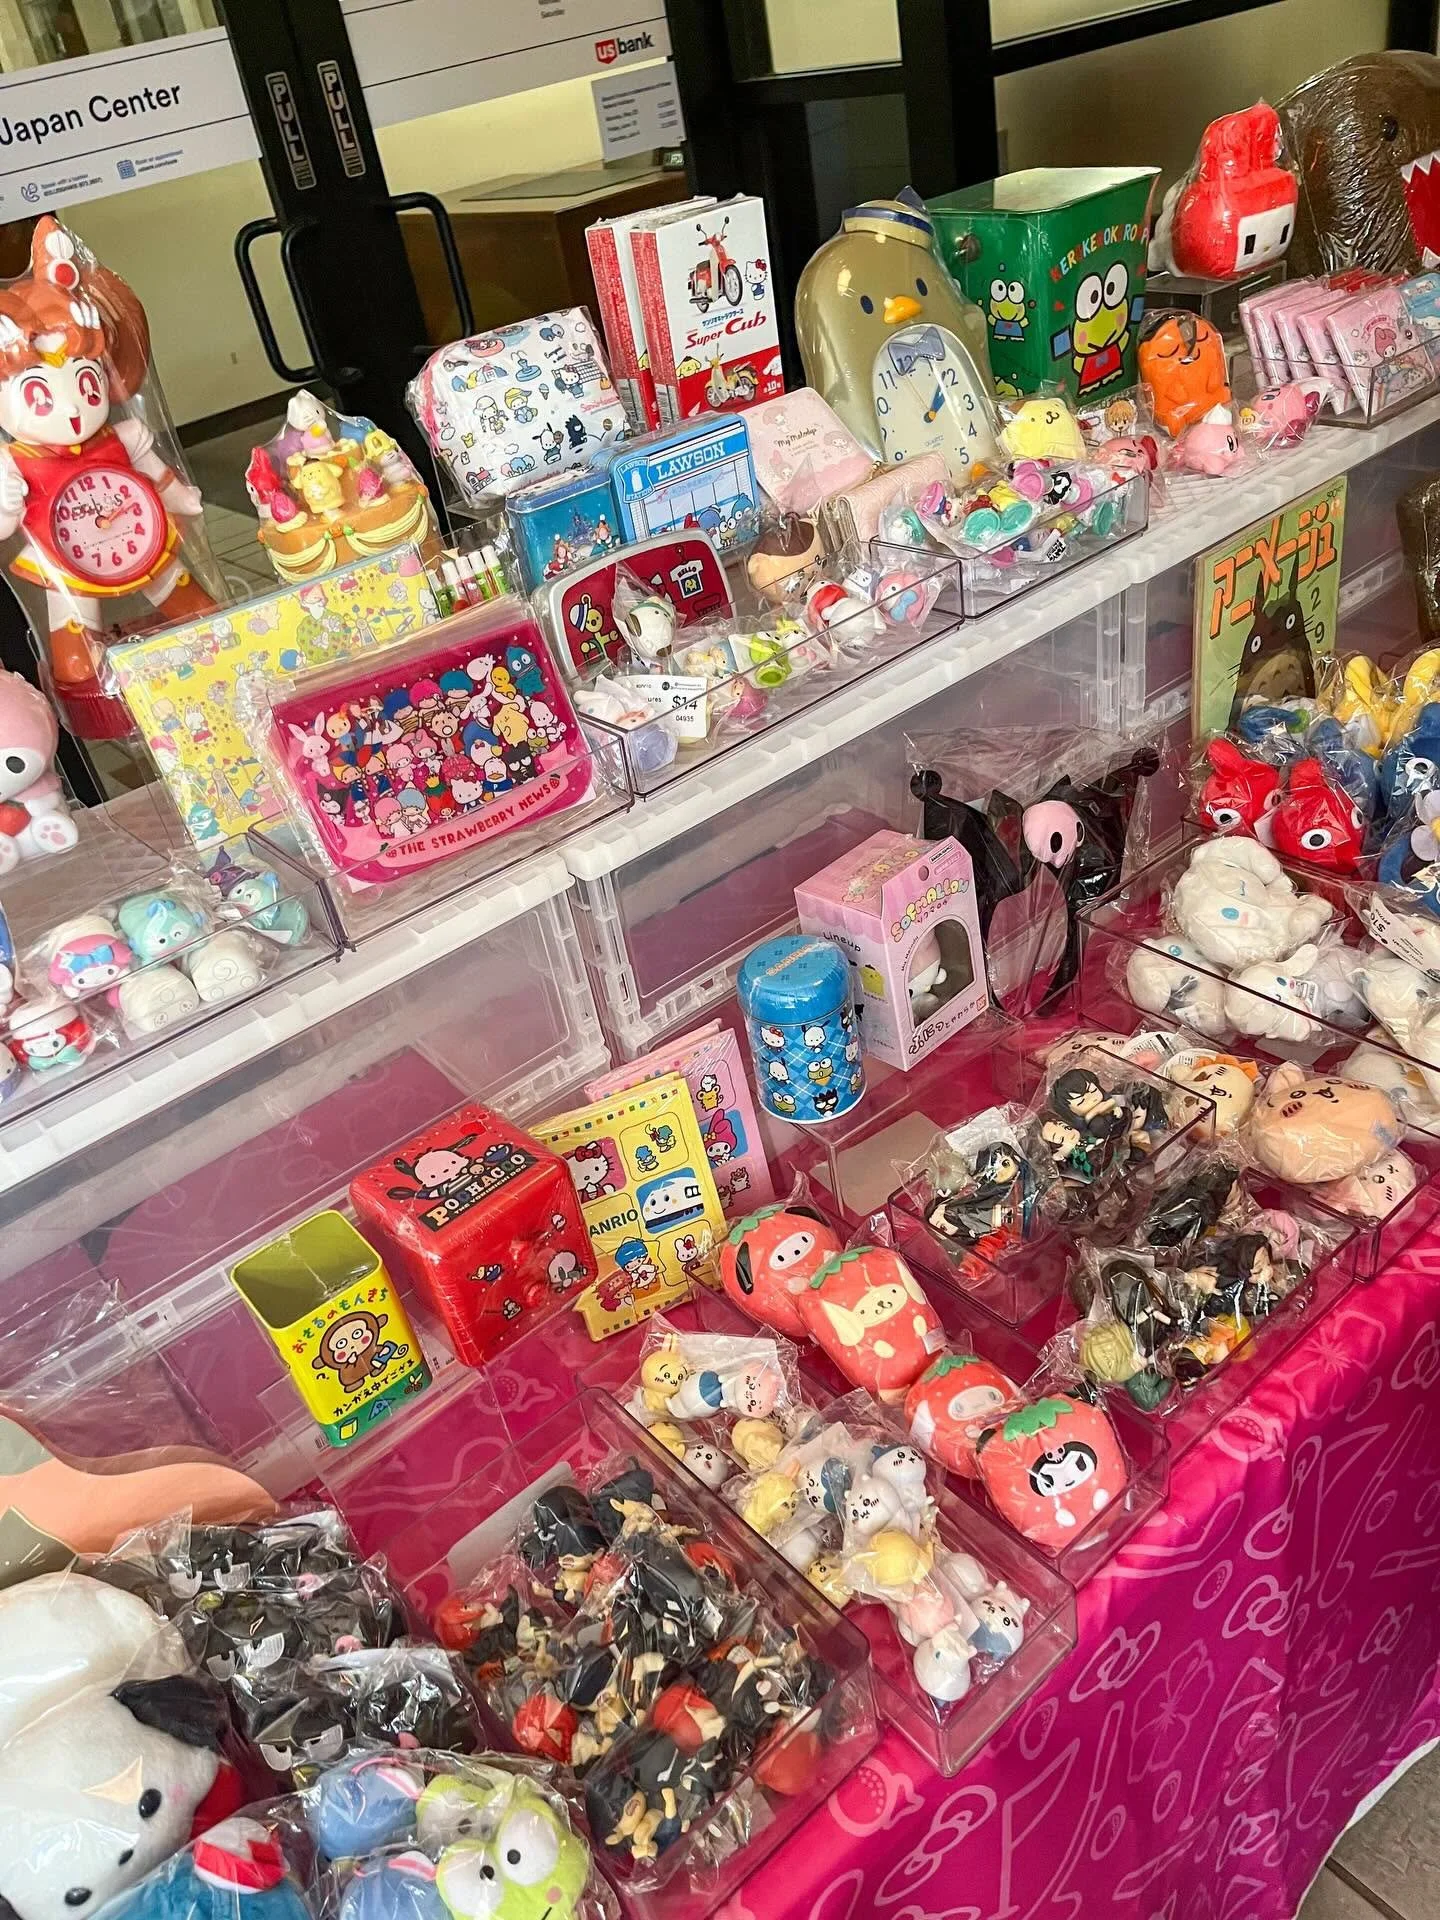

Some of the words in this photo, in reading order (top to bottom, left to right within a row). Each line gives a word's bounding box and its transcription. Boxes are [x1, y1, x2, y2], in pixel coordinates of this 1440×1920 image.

[617, 32, 654, 55] bank
[0, 109, 84, 146] Japan
[88, 85, 181, 123] Center
[324, 72, 355, 150] PULL
[272, 83, 305, 161] PULL
[685, 330, 723, 350] Super
[725, 310, 767, 335] Cub
[877, 397, 889, 415] 0
[963, 394, 974, 411] 3
[968, 422, 978, 438] 4
[655, 441, 726, 480] LAWSON
[959, 447, 970, 465] 5
[620, 458, 647, 474] LAWSON
[77, 475, 96, 492] 12
[102, 475, 111, 489] 1
[64, 487, 78, 503] 11
[119, 485, 132, 499] 2
[57, 505, 70, 523] 10
[59, 527, 70, 542] 9
[134, 522, 145, 536] 4
[72, 544, 84, 559] 8
[92, 553, 102, 567] 7
[112, 552, 122, 566] 6
[677, 566, 697, 578] HELLO
[671, 694, 698, 711] $14
[400, 840, 426, 856] THE
[431, 807, 516, 849] STRAWBERRY
[518, 783, 551, 811] NEWS
[890, 877, 970, 943] SOFMALLOW
[823, 931, 861, 952] Lineup
[588, 1208, 639, 1238] ANRIO
